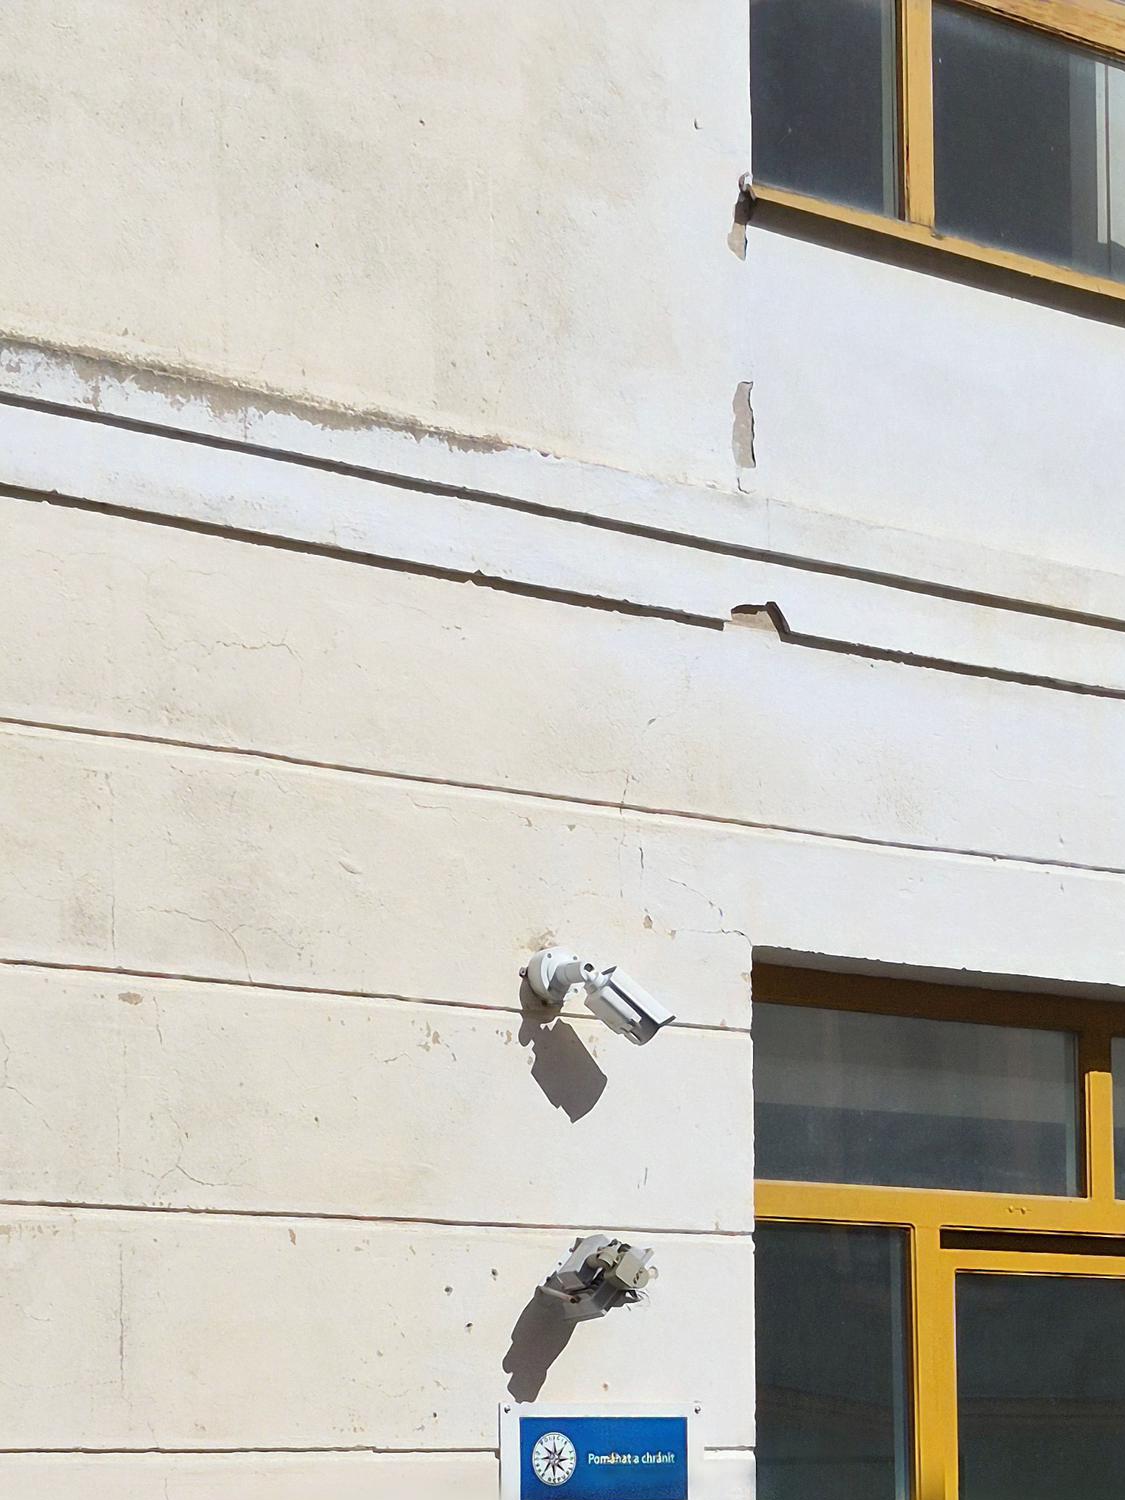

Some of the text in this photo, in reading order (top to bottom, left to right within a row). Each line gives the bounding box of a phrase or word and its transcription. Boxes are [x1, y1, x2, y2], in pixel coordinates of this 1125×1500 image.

[587, 1451, 676, 1465] Pomáhat a chránit
